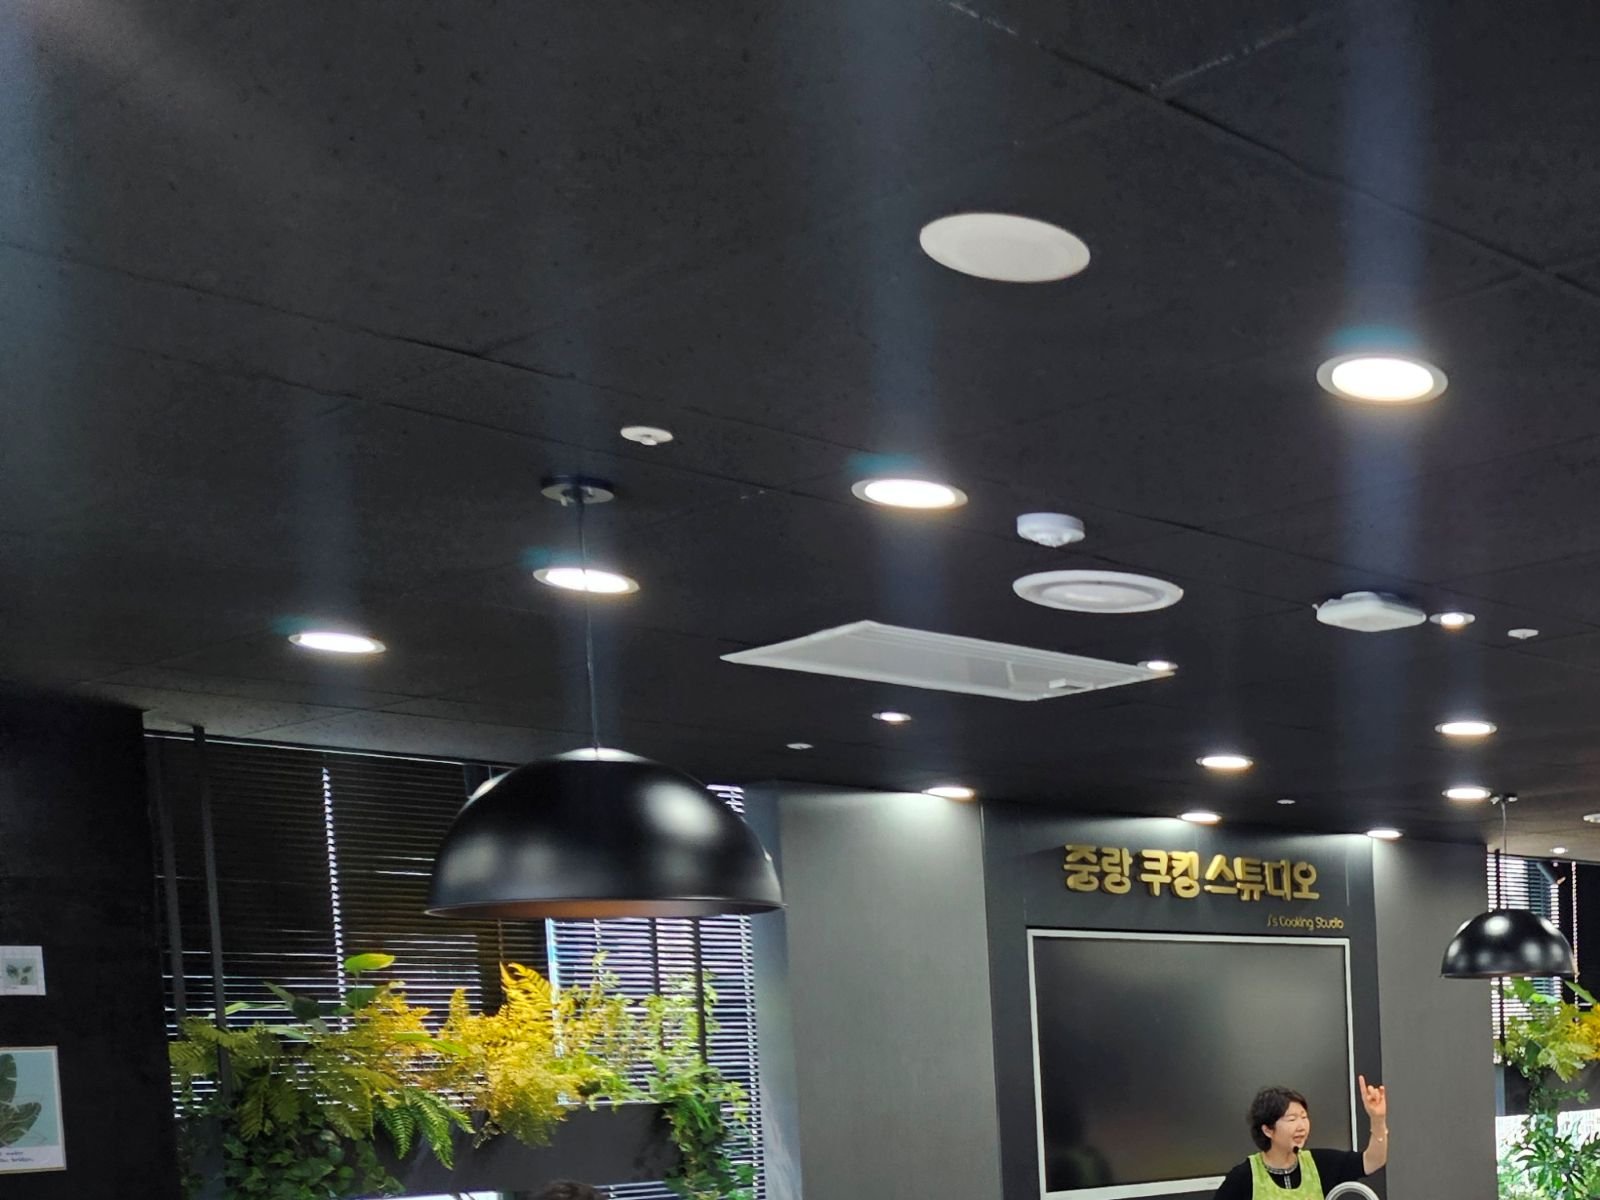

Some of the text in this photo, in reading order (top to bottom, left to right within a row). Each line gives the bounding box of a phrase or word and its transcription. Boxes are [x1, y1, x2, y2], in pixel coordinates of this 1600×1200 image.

[1063, 844, 1320, 901] 중랑 쿠킹 스튜디오
[1279, 916, 1314, 931] Cooking
[1315, 916, 1344, 929] Studio
